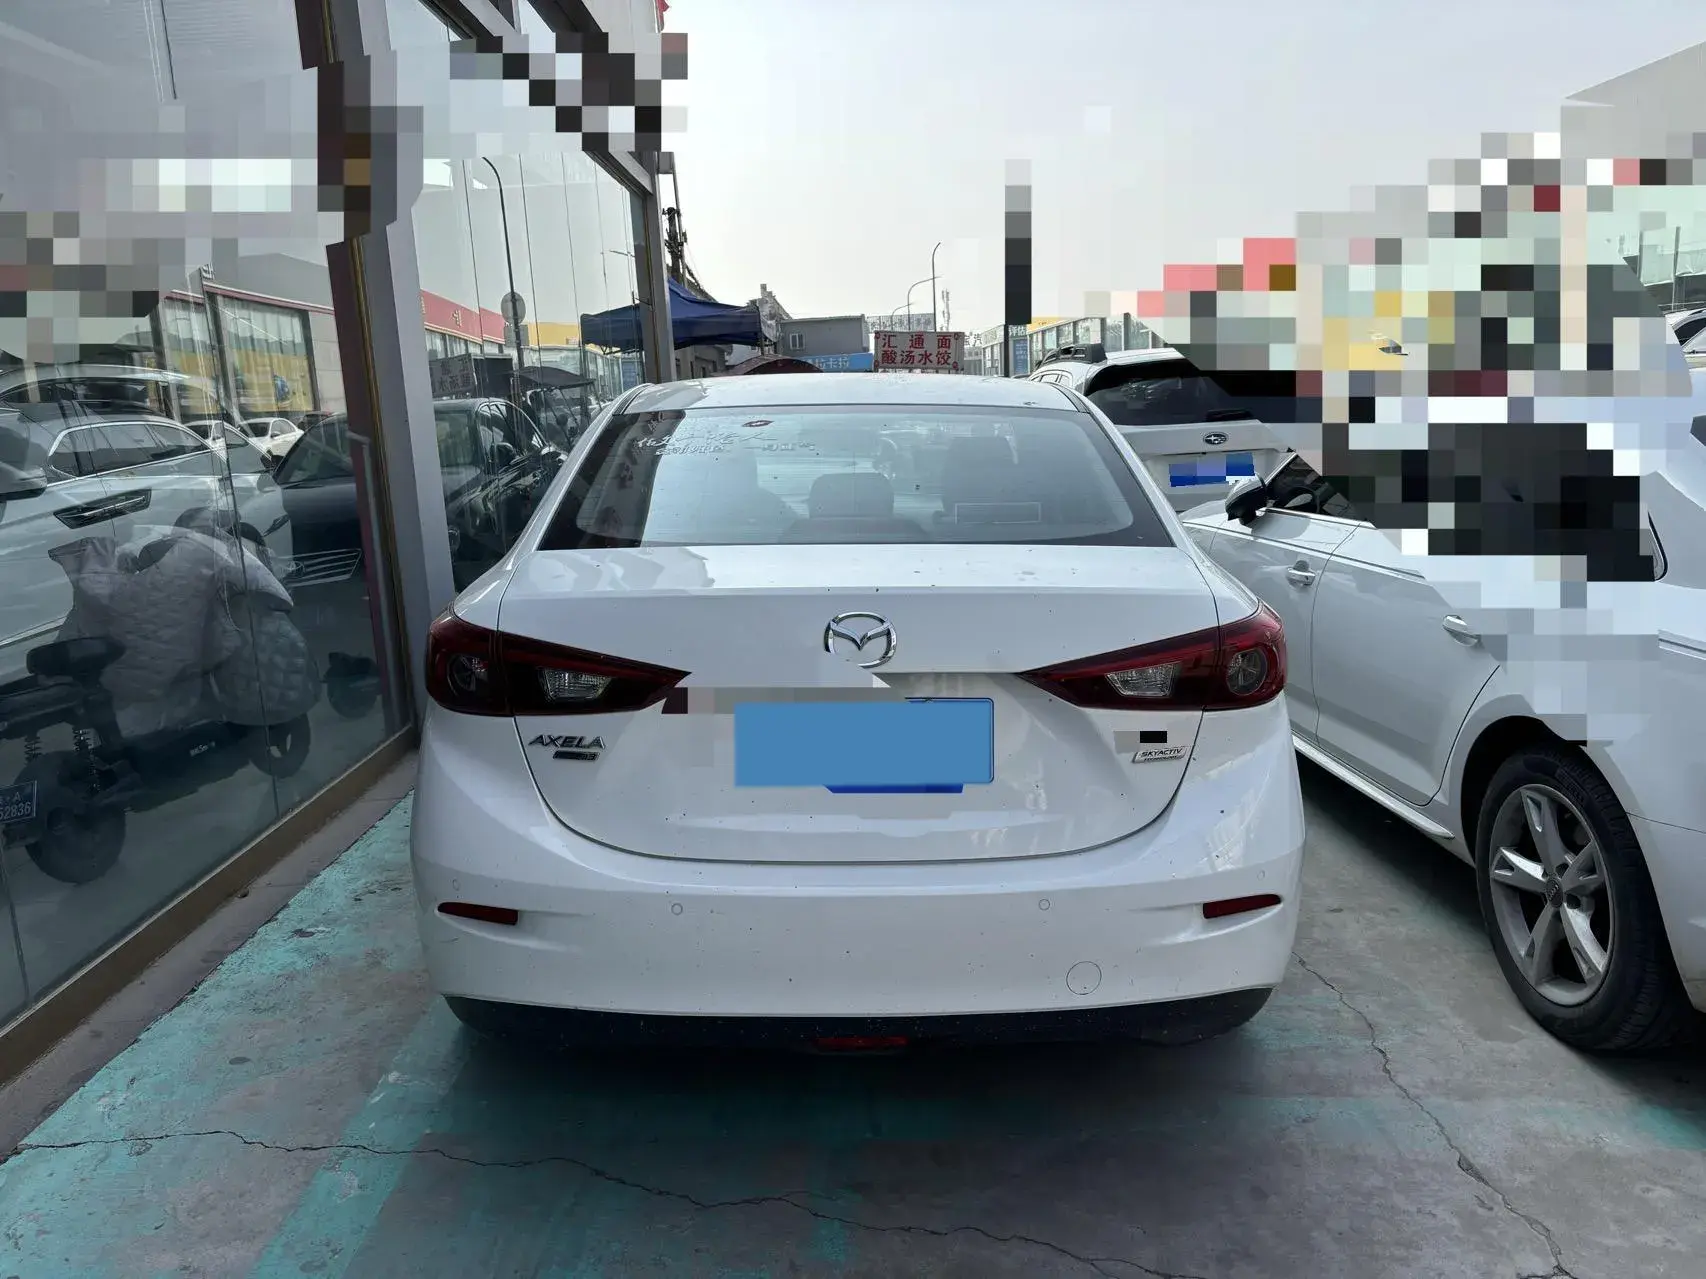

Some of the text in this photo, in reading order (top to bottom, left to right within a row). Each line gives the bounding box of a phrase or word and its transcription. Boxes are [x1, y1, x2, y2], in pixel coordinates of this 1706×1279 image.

[881, 334, 952, 350] 汇通面
[881, 350, 952, 366] 酸汤水饺
[528, 734, 606, 750] AXELA
[1141, 748, 1182, 758] SKYACTIV
